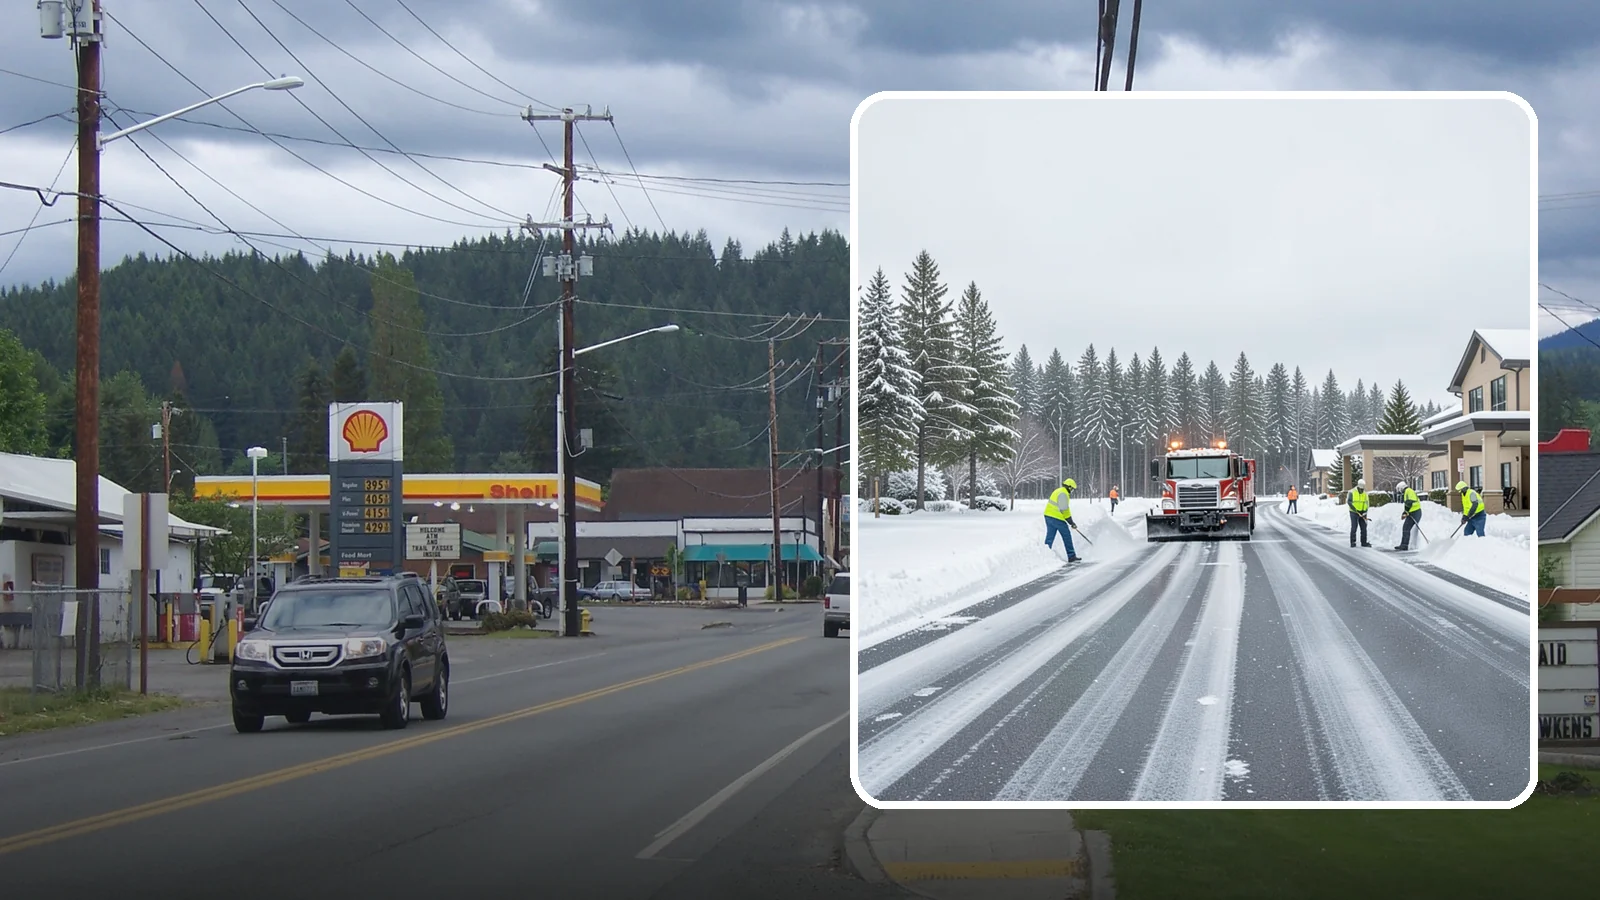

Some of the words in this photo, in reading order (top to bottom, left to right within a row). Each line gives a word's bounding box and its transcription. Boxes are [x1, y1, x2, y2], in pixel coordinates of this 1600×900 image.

[365, 480, 384, 490] 395
[490, 484, 547, 499] Shell
[365, 494, 384, 504] 405
[365, 508, 384, 518] 415
[365, 522, 384, 532] 429
[1538, 643, 1567, 665] AID
[1538, 716, 1592, 739] WKENS
